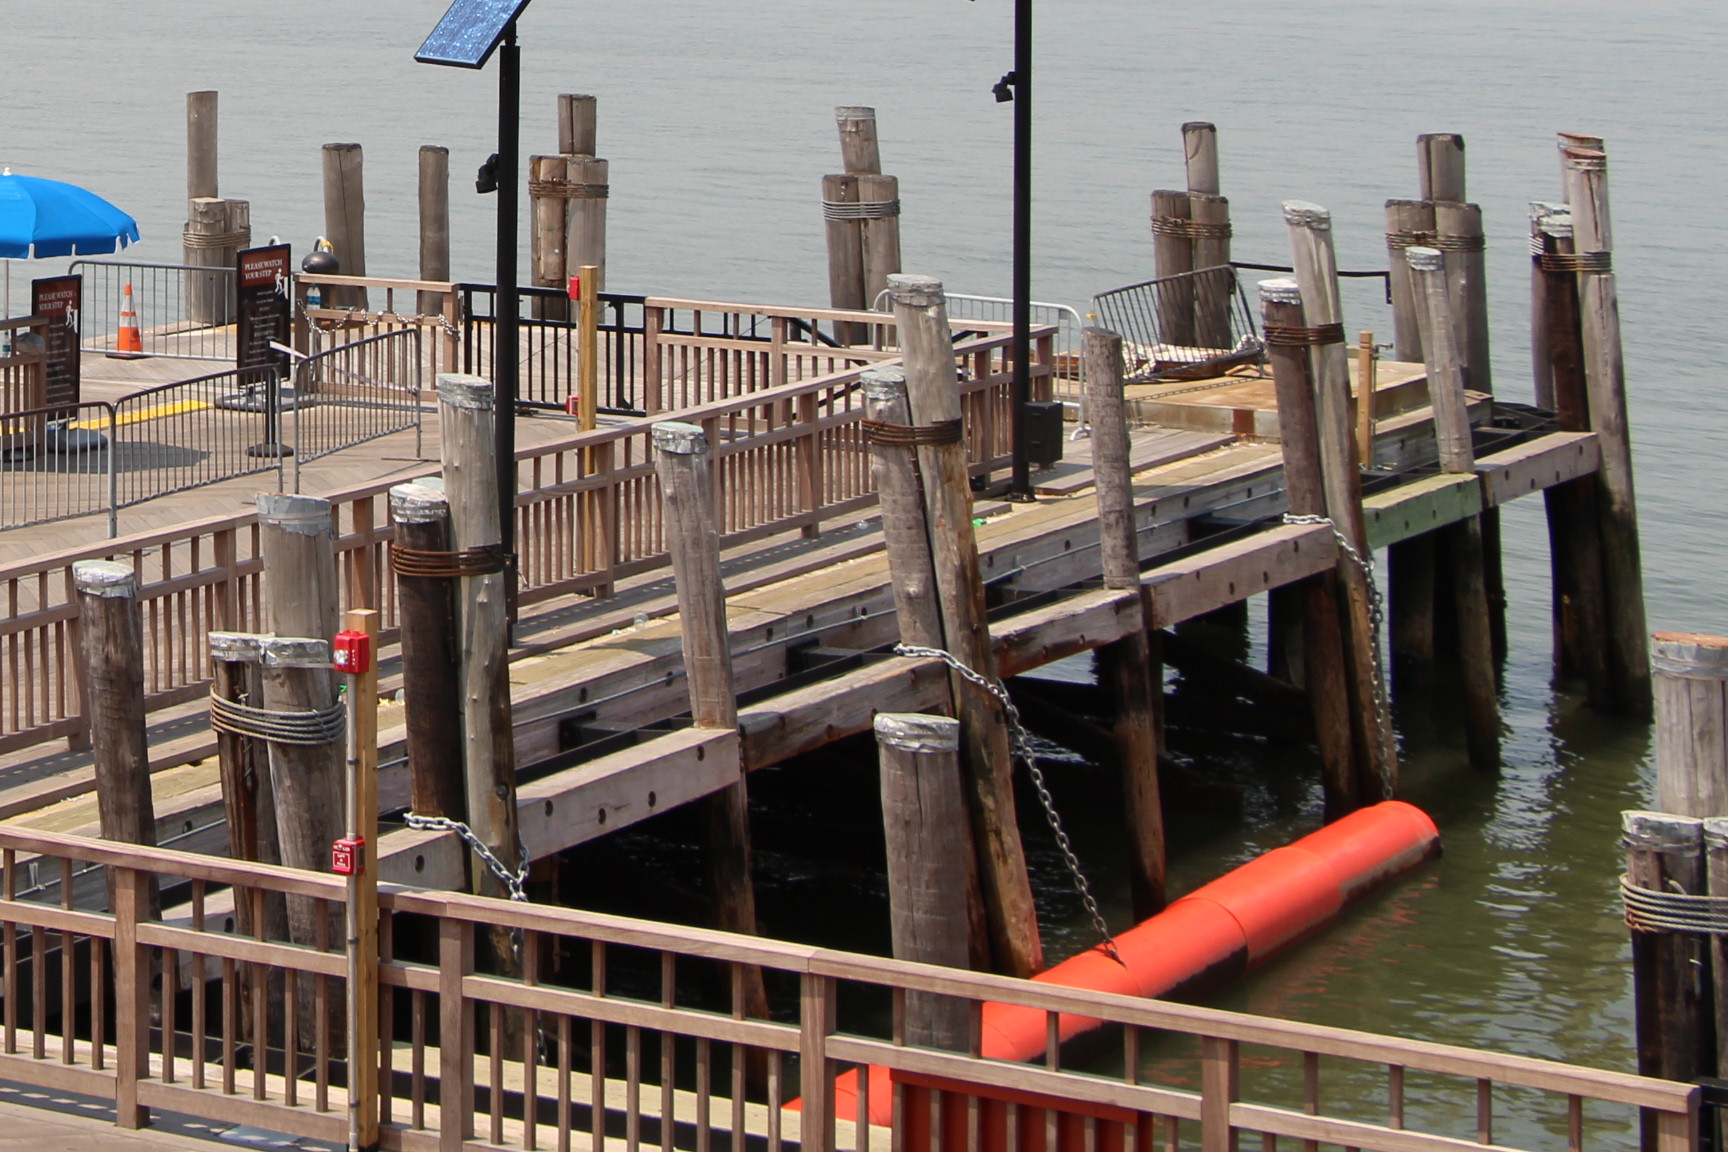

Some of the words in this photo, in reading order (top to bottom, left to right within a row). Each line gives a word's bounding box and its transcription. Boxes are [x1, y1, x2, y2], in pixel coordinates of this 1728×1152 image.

[244, 261, 263, 271] PLEASE
[263, 258, 283, 268] WATCH
[244, 271, 259, 280] YOUR
[259, 269, 272, 278] STEP
[39, 292, 56, 302] PLEASE
[56, 291, 73, 299] WATCH
[39, 302, 52, 311] YOUR
[52, 301, 64, 310] STEP
